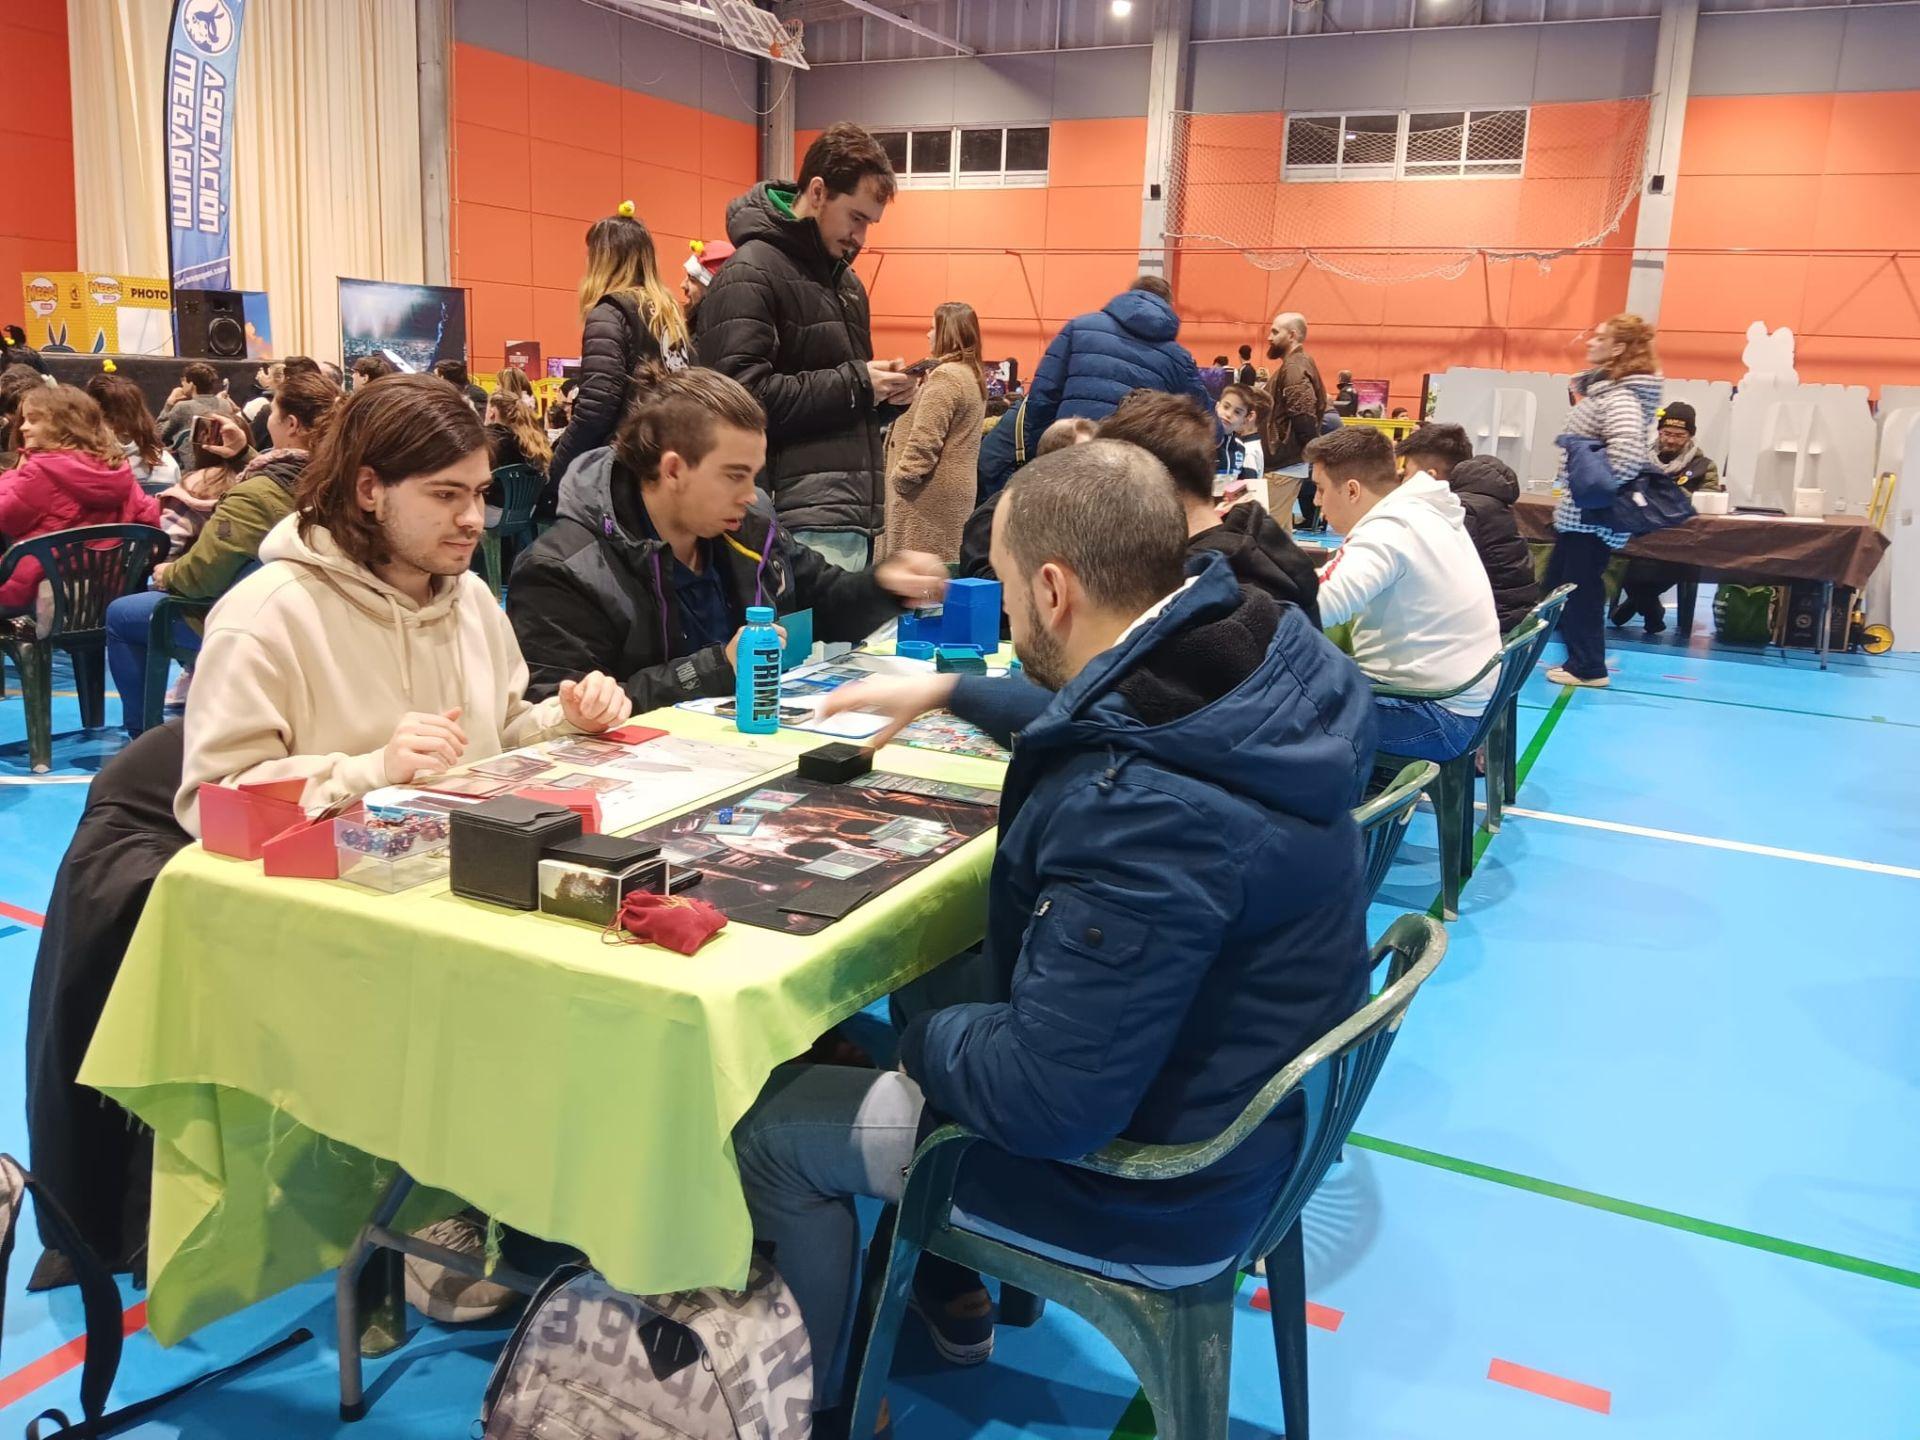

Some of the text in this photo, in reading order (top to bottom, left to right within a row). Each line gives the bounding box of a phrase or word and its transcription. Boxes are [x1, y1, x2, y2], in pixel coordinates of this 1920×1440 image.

[171, 52, 198, 229] MEGAGUMI
[200, 64, 226, 233] ASOCIACIÓN
[131, 288, 168, 299] PHOTO
[754, 649, 779, 721] PRIME
